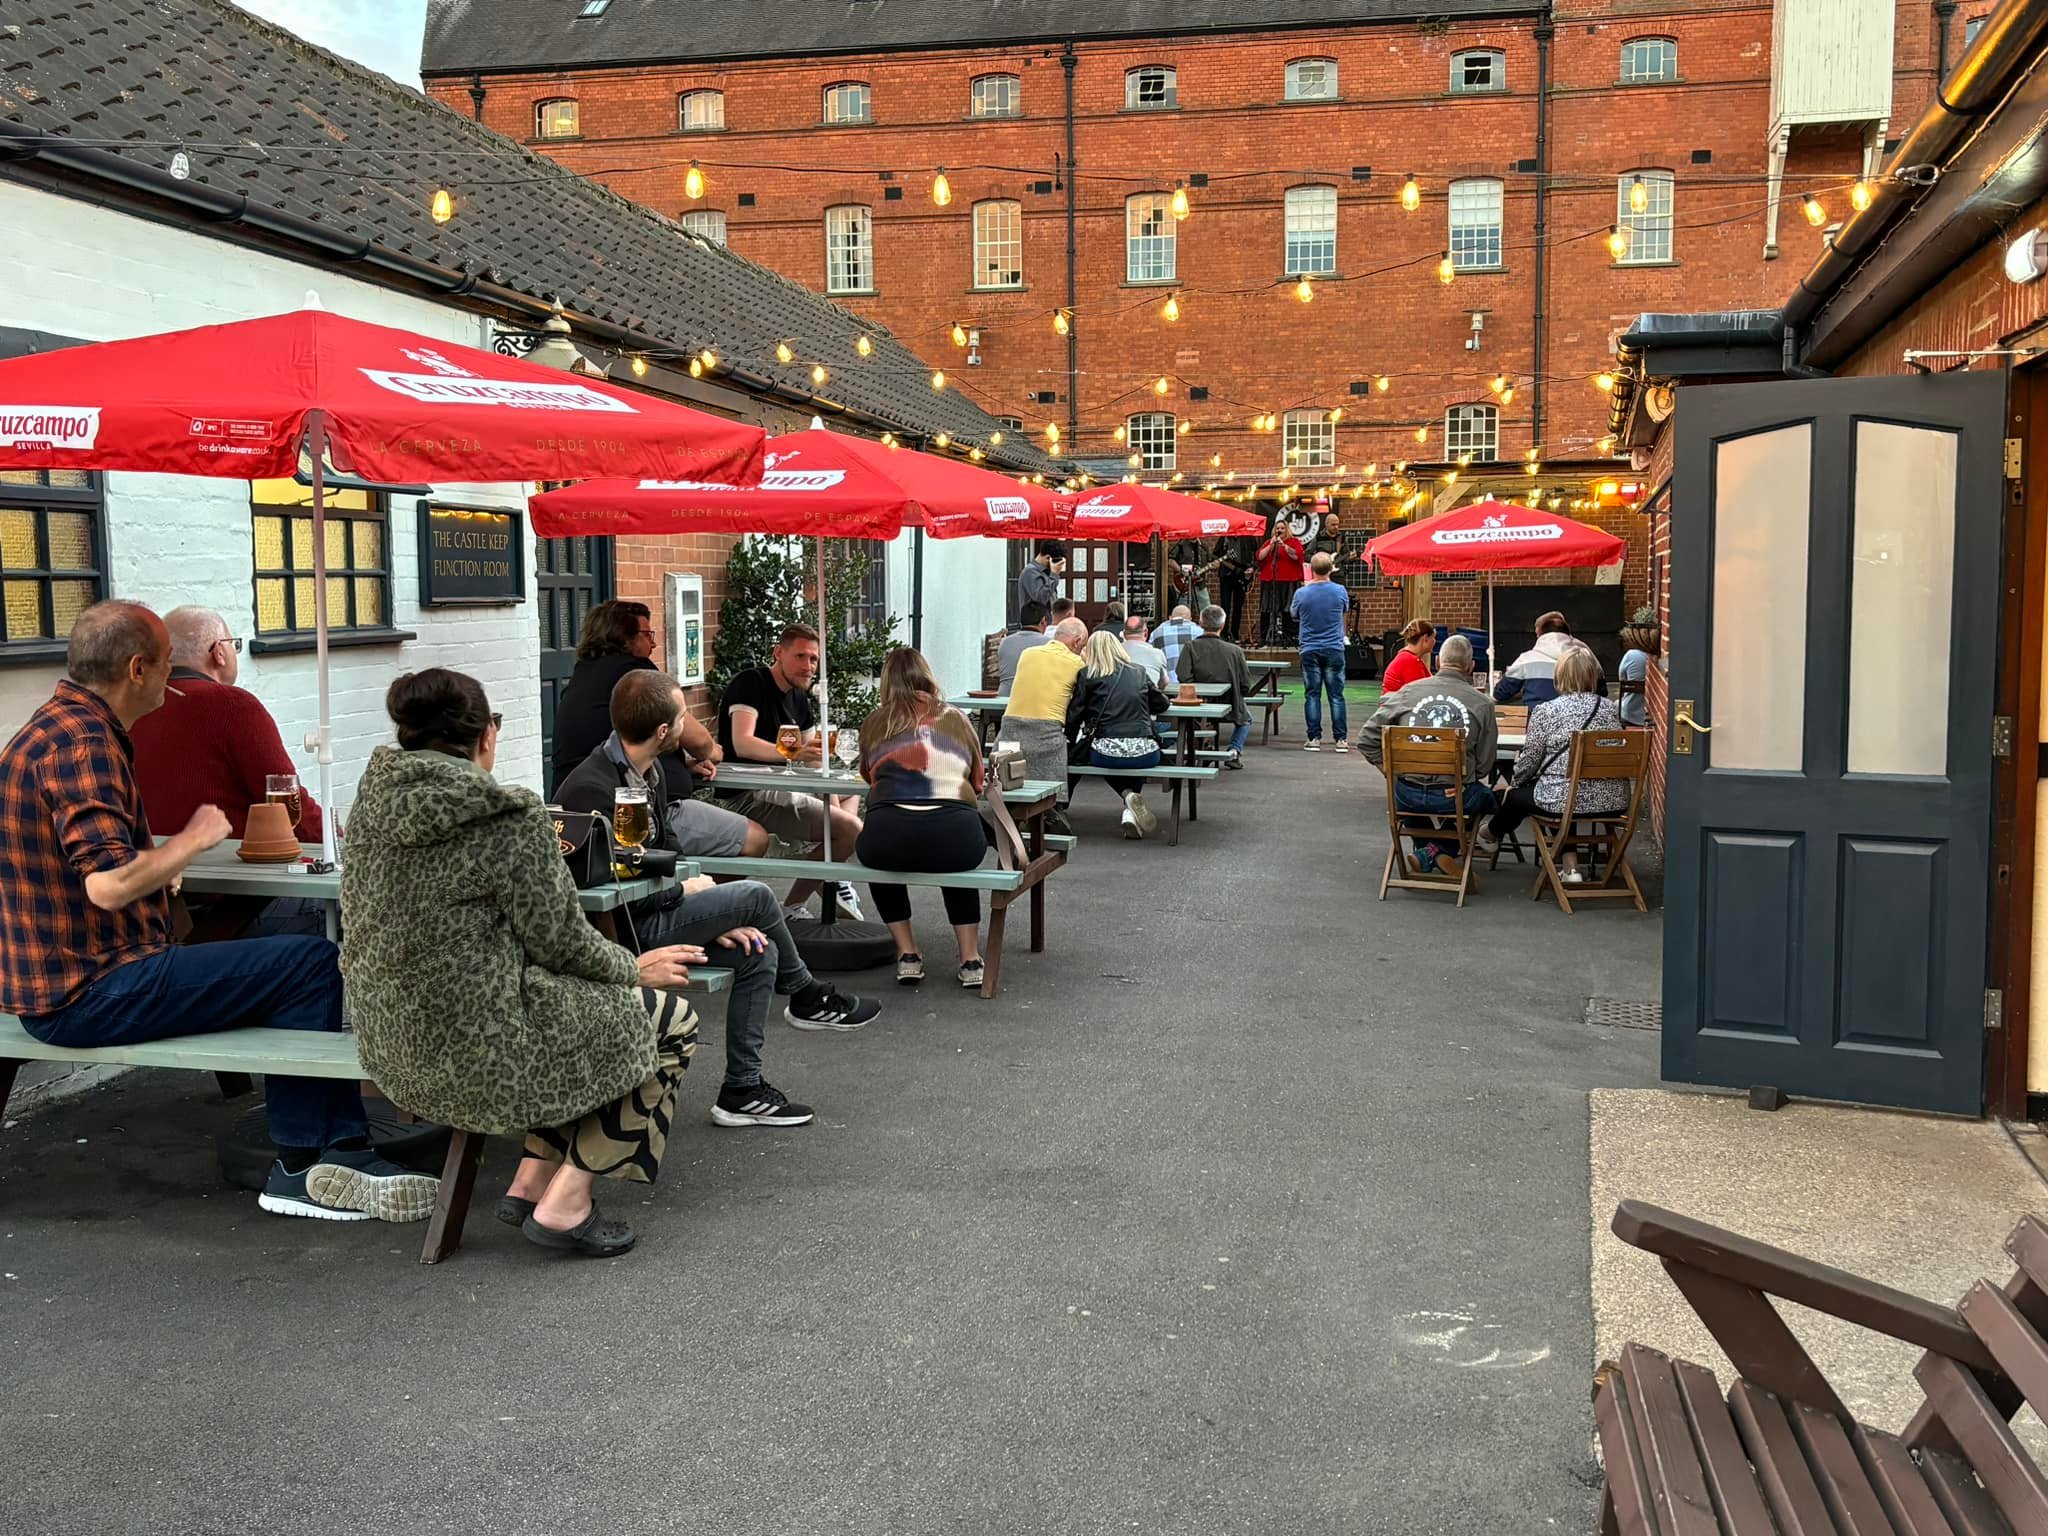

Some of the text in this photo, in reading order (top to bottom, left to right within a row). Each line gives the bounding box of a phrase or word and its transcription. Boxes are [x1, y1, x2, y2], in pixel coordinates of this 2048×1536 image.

[387, 376, 610, 406] Cruzcampo
[0, 414, 90, 442] uzcampo
[16, 442, 52, 450] SEVILLA
[399, 439, 481, 455] CERVEZA
[536, 439, 585, 453] DESDE
[593, 439, 626, 455] 1904
[571, 509, 630, 521] CERVEZA
[671, 508, 713, 518] DESDE
[720, 508, 749, 518] 1904
[804, 511, 821, 521] DE
[433, 530, 509, 550] THE CASTLE KEEP
[1441, 528, 1553, 541] Cruzcampo
[434, 559, 510, 577] FUNCTION ROOM
